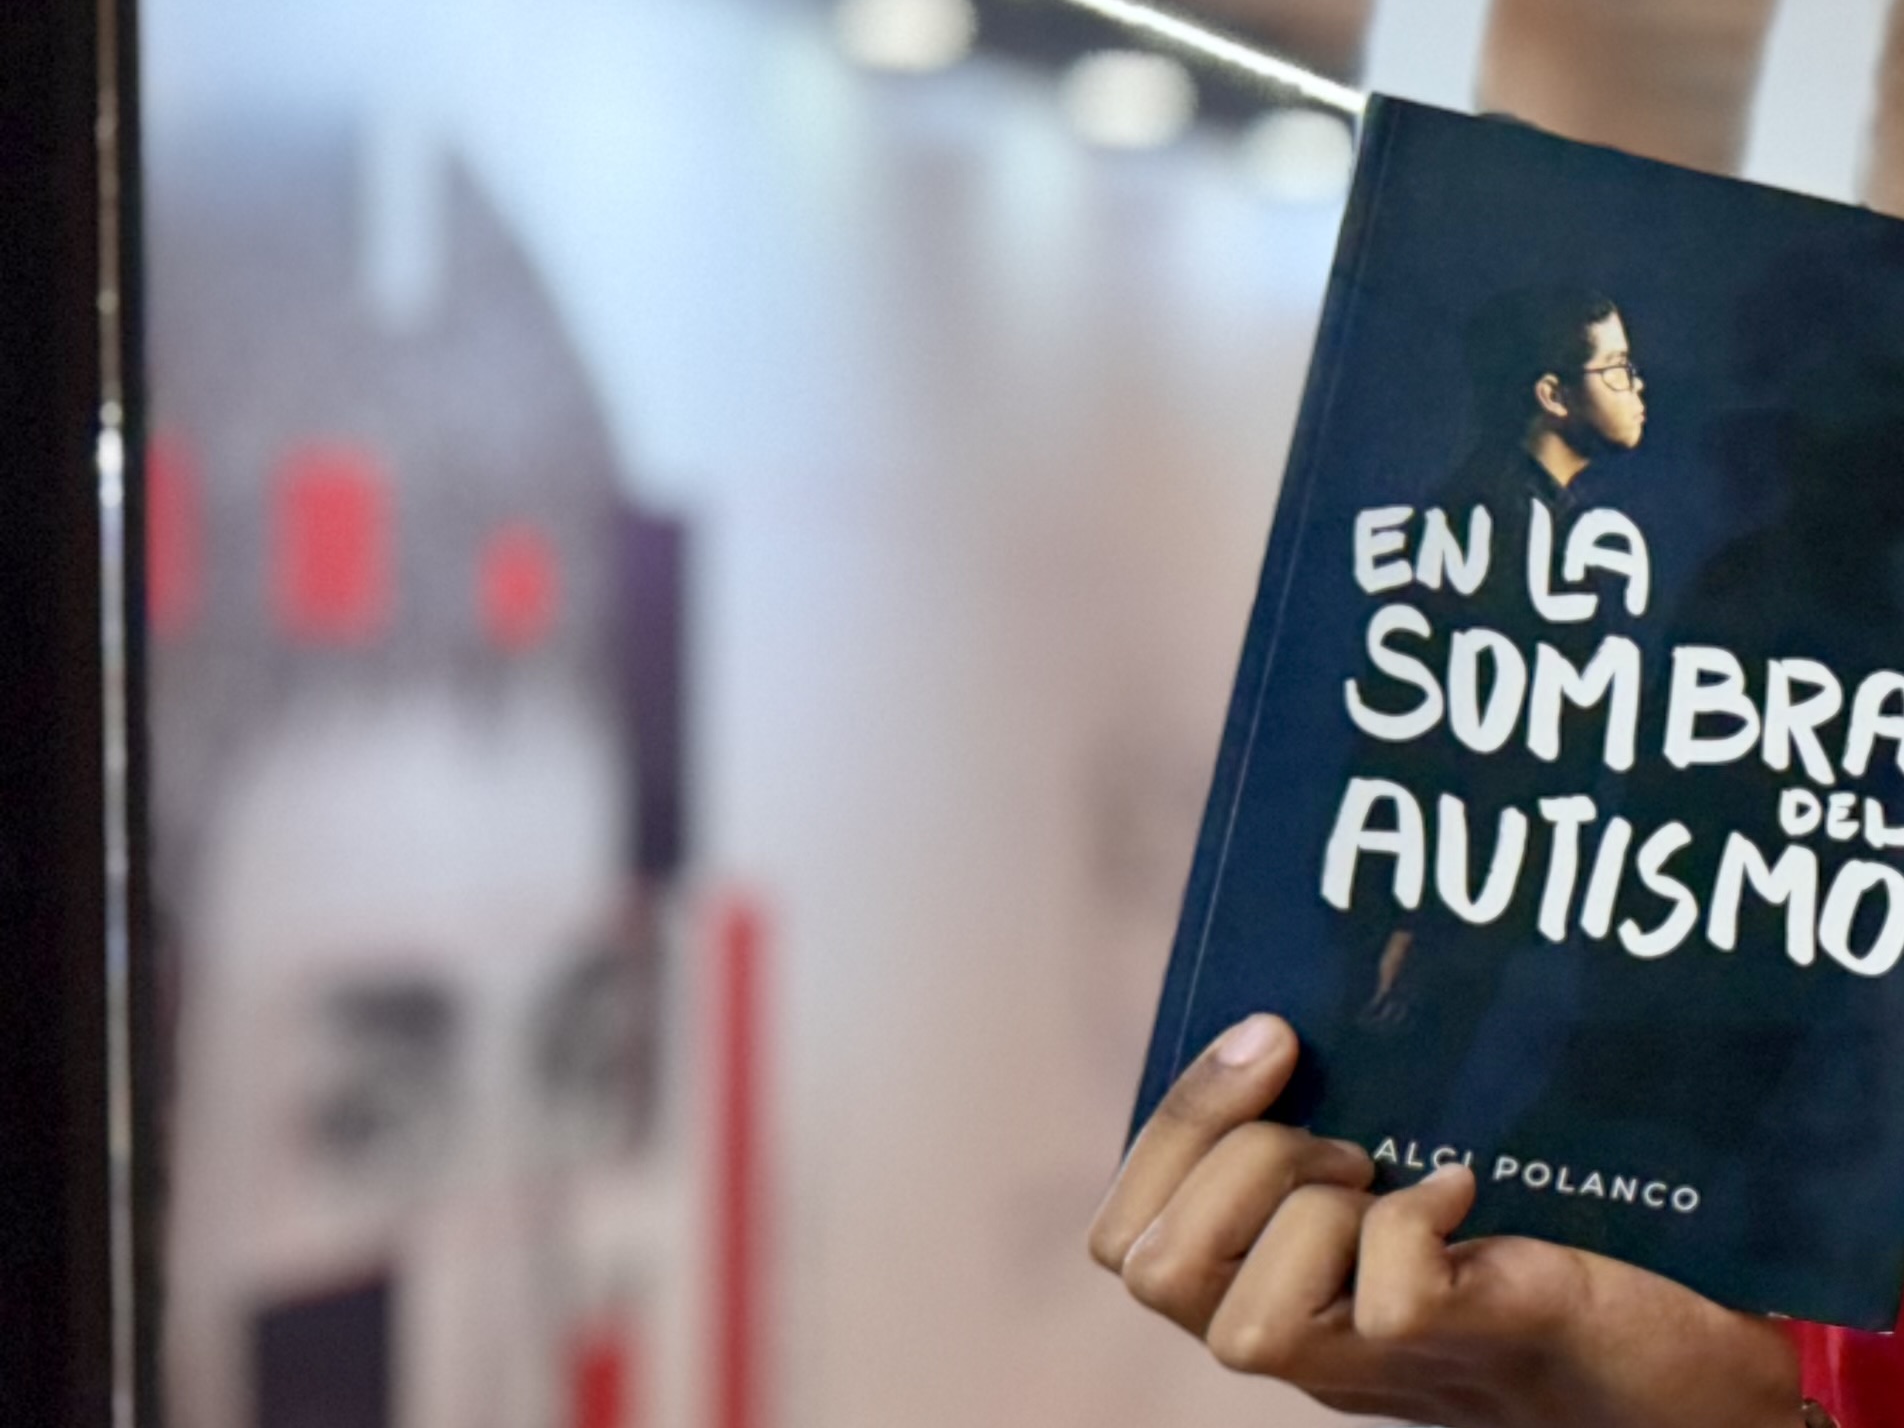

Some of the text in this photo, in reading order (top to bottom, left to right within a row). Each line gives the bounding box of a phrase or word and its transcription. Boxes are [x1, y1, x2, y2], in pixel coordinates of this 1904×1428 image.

[1353, 498, 1650, 623] EN LA
[1492, 1156, 1701, 1213] POLANCO
